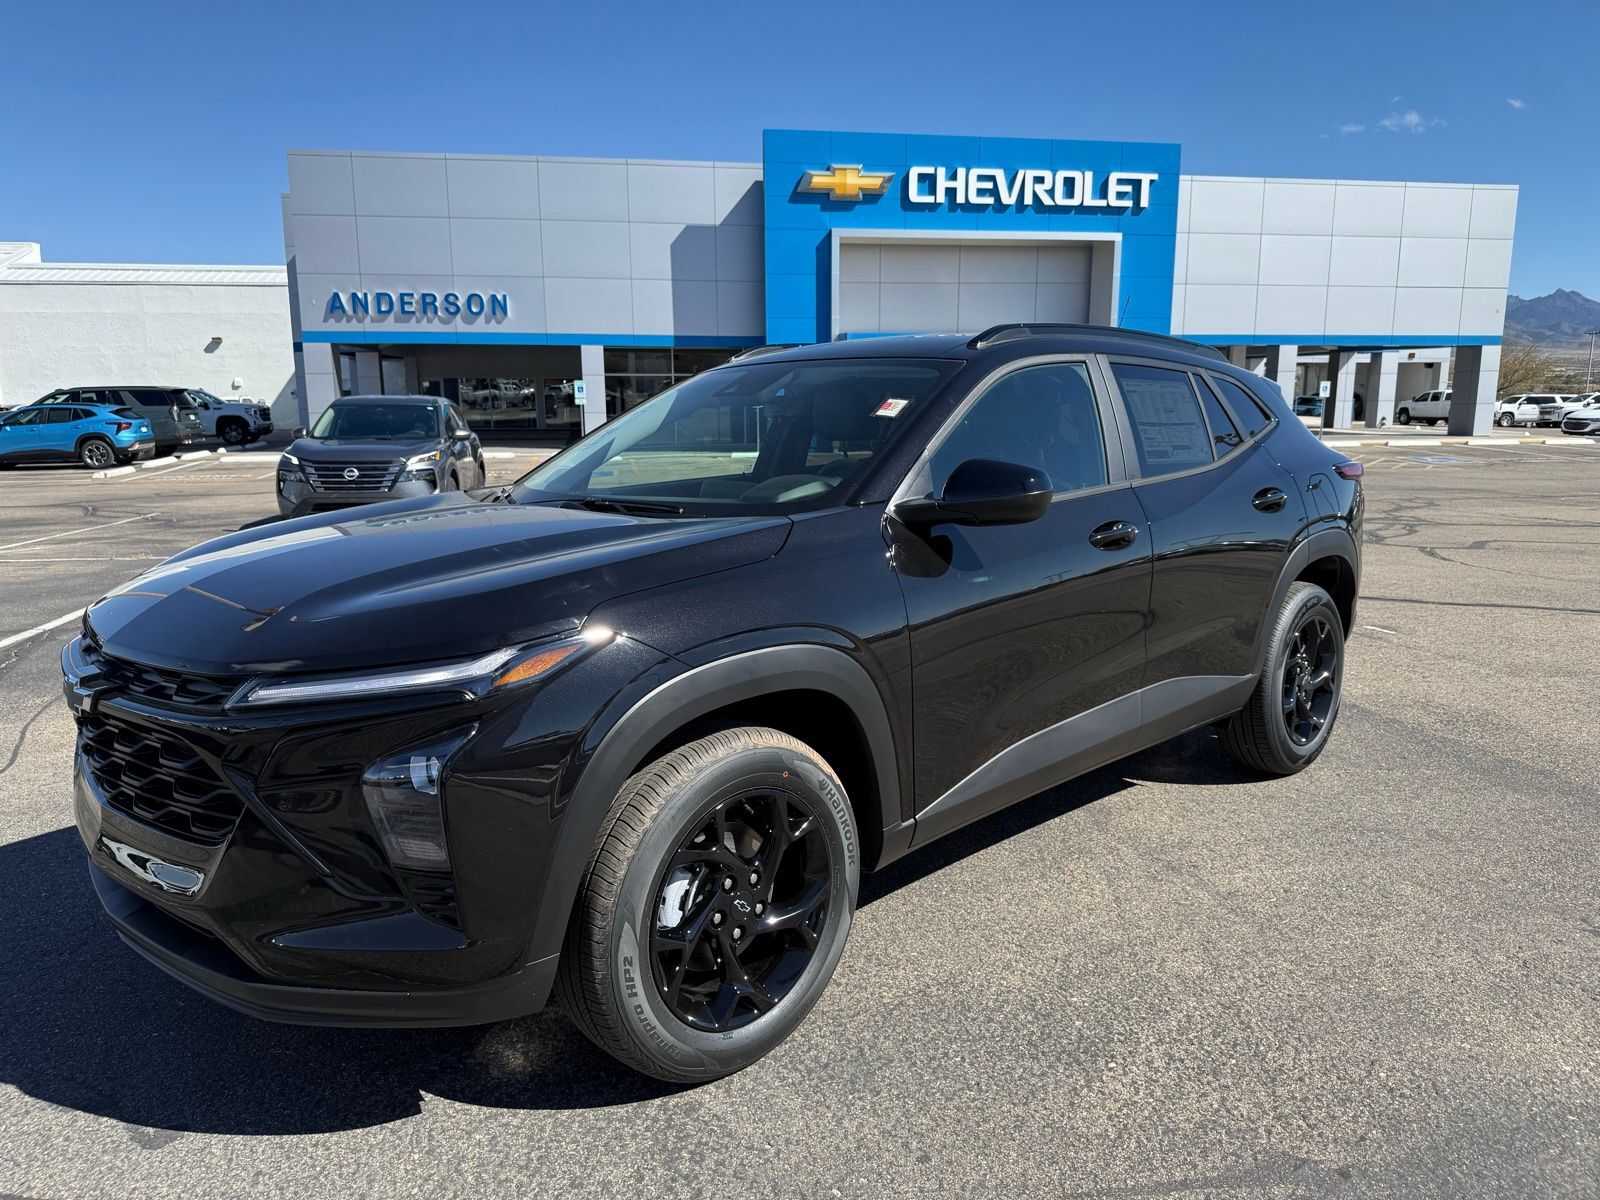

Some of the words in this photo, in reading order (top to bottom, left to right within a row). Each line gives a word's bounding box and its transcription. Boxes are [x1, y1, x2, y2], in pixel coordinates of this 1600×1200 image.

[908, 165, 1159, 209] CHEVROLET
[328, 291, 509, 318] ANDERSON
[622, 955, 639, 999] HP2
